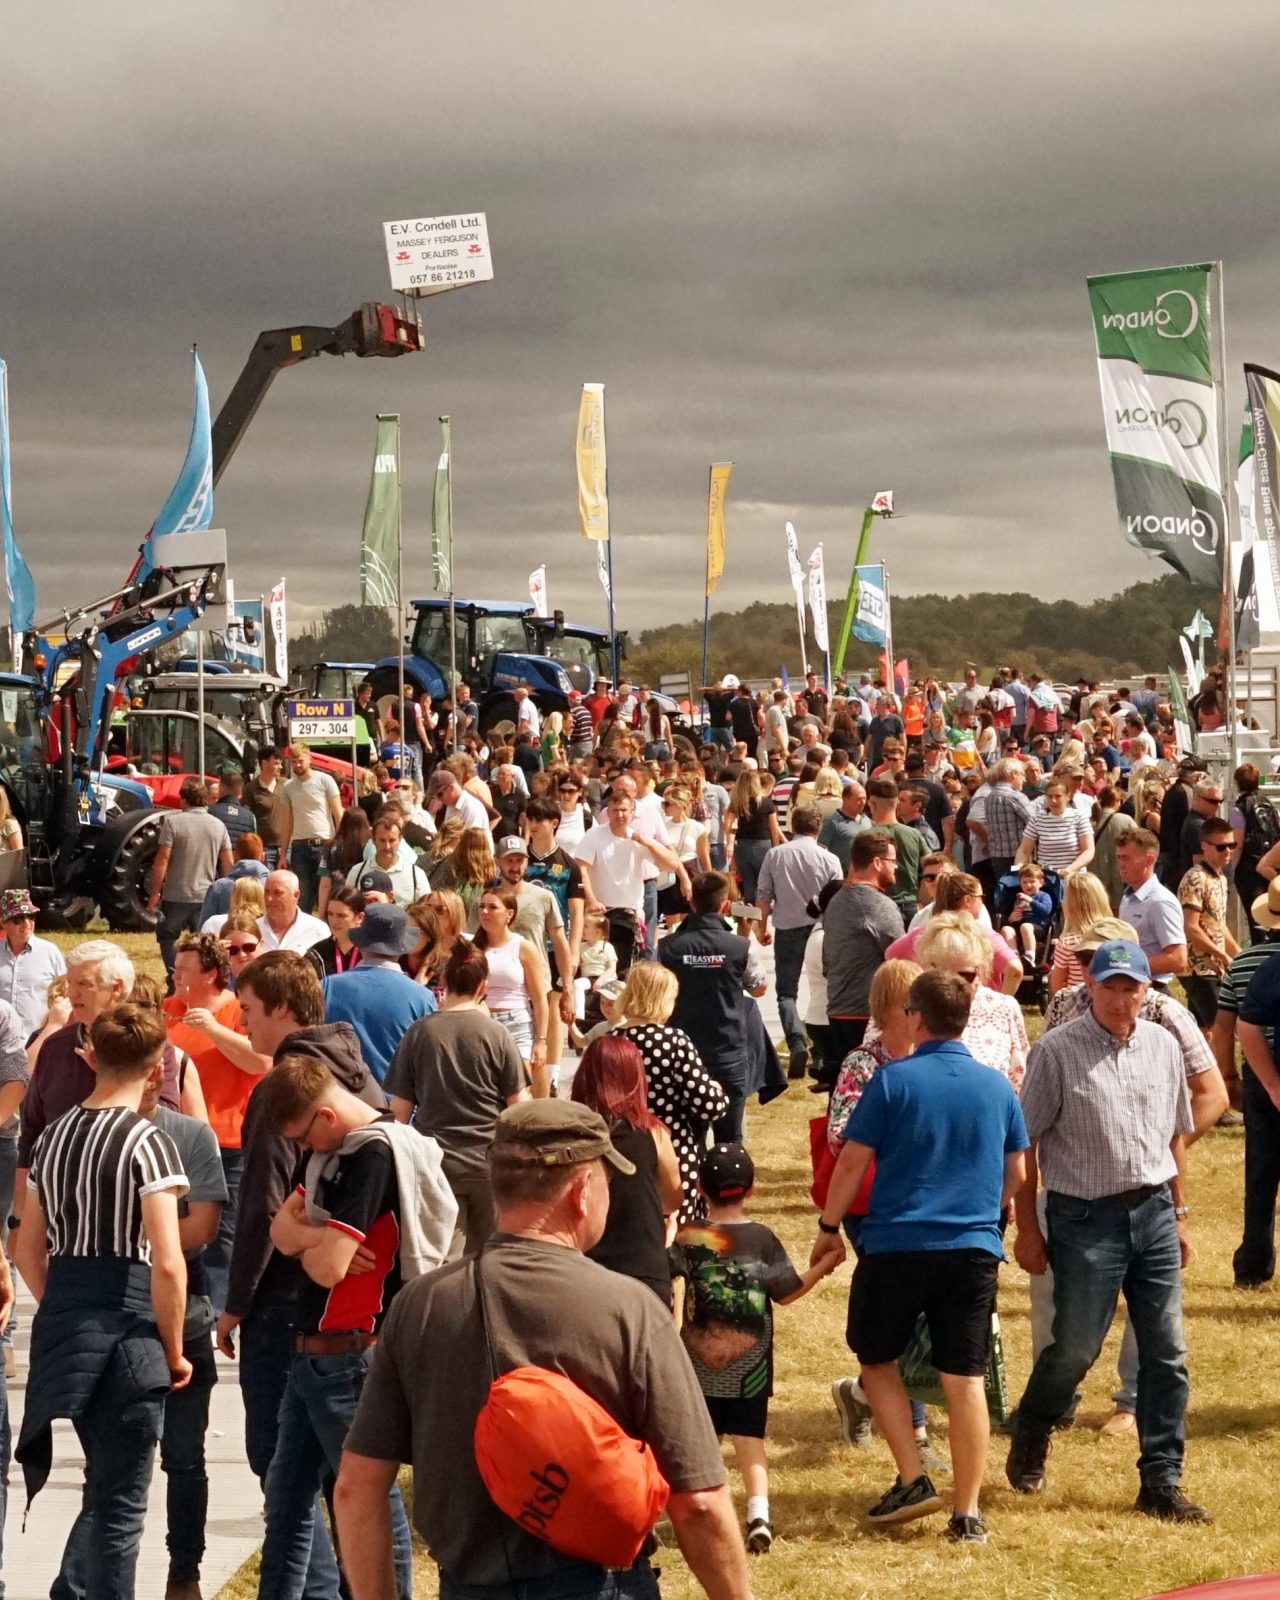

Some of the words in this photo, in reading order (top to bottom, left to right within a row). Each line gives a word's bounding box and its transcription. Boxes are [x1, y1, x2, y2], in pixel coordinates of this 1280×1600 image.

[391, 224, 411, 235] E.V.
[415, 219, 456, 232] Condell
[461, 217, 481, 228] Ltd.
[397, 238, 431, 248] MASSEY
[434, 233, 478, 244] FERGUSON
[421, 249, 459, 259] DEALERS
[410, 274, 427, 284] 057
[431, 273, 443, 282] 86
[446, 270, 475, 281] 21218
[296, 703, 328, 716] Row
[333, 703, 345, 715] N
[299, 723, 318, 734] 297
[329, 723, 348, 734] 304
[517, 1462, 569, 1540] ptsb
